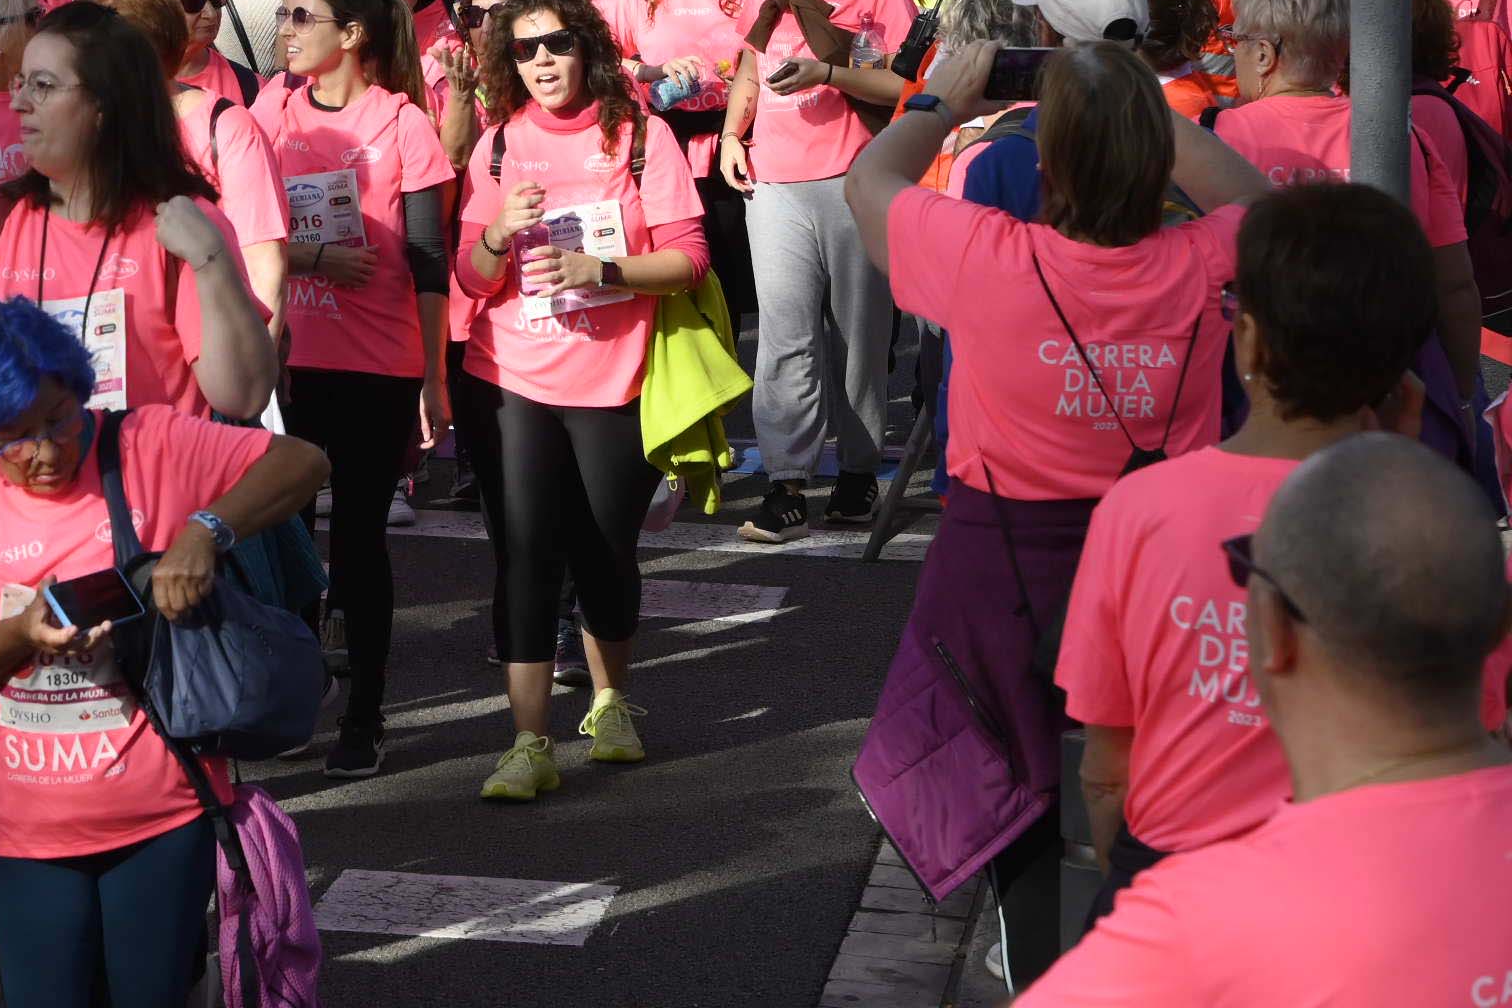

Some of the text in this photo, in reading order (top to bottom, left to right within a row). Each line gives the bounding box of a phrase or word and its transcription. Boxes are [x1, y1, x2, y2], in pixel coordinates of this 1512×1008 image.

[290, 214, 323, 230] 016
[1039, 340, 1176, 368] CARRERA
[1065, 369, 1151, 392] DE LA
[1055, 394, 1155, 417] MUJER
[1170, 595, 1248, 635] CAR
[1199, 635, 1249, 672] DE
[46, 670, 88, 687] 18307
[1189, 668, 1261, 707] MUJ
[10, 691, 49, 702] CARRERA
[50, 693, 64, 701] DE
[65, 692, 78, 700] LA
[9, 708, 122, 723] OYSHO Santa
[5, 732, 118, 772] SUMA
[39, 776, 49, 784] DE
[50, 777, 61, 785] LA
[63, 774, 94, 785] MUJER
